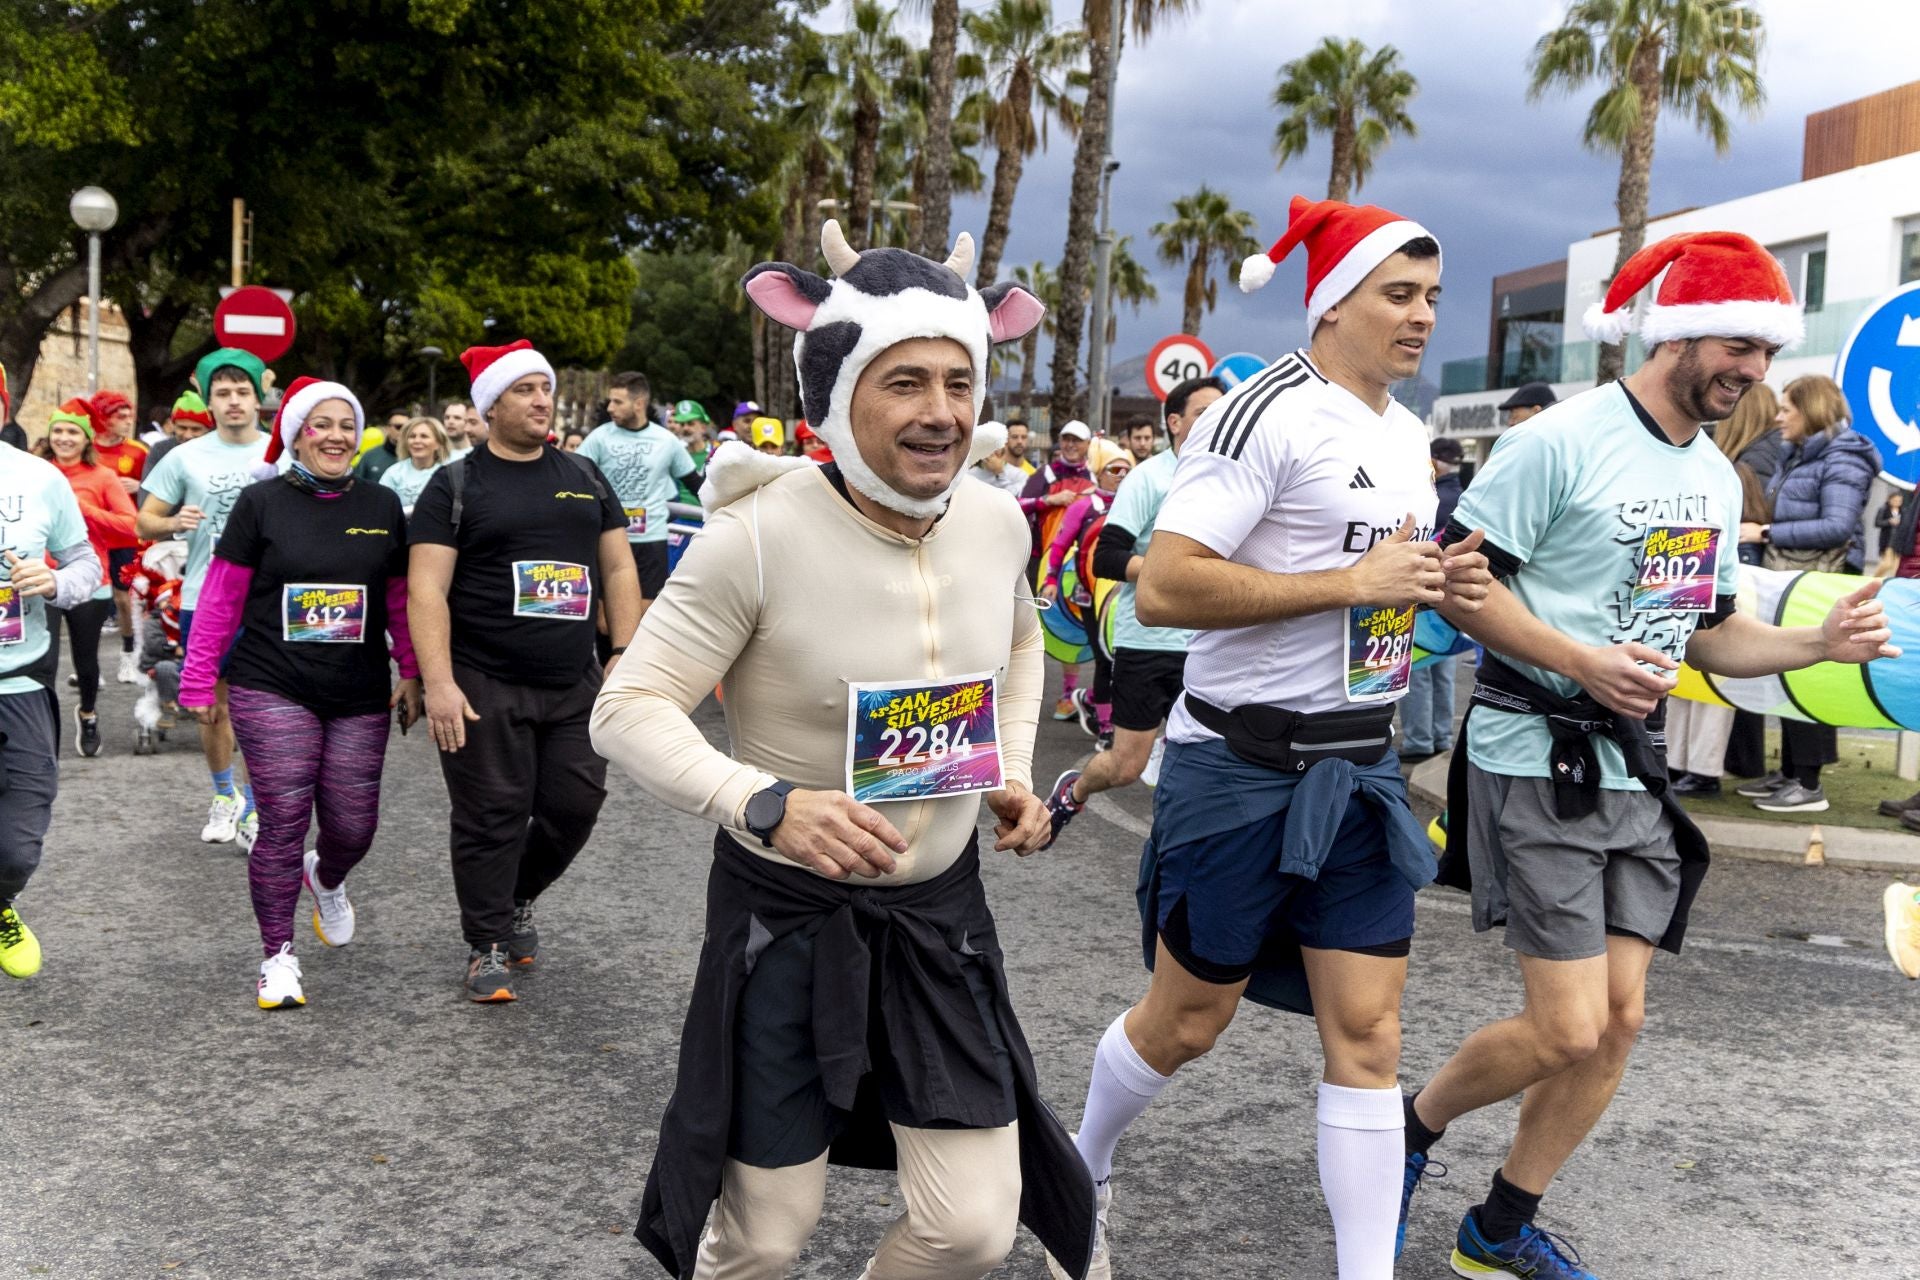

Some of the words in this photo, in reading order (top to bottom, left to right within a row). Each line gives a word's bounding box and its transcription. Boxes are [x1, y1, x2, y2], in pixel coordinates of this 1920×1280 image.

[1161, 358, 1201, 381] 40
[1641, 555, 1701, 586] 2302
[537, 580, 573, 600] 613
[306, 606, 347, 625] 612
[1371, 607, 1396, 625] SAN
[1365, 633, 1411, 669] 2287
[887, 683, 985, 730] SILVESTRE
[888, 690, 931, 715] SAN
[931, 699, 983, 727] CARTAGENA
[878, 720, 973, 766] 2284
